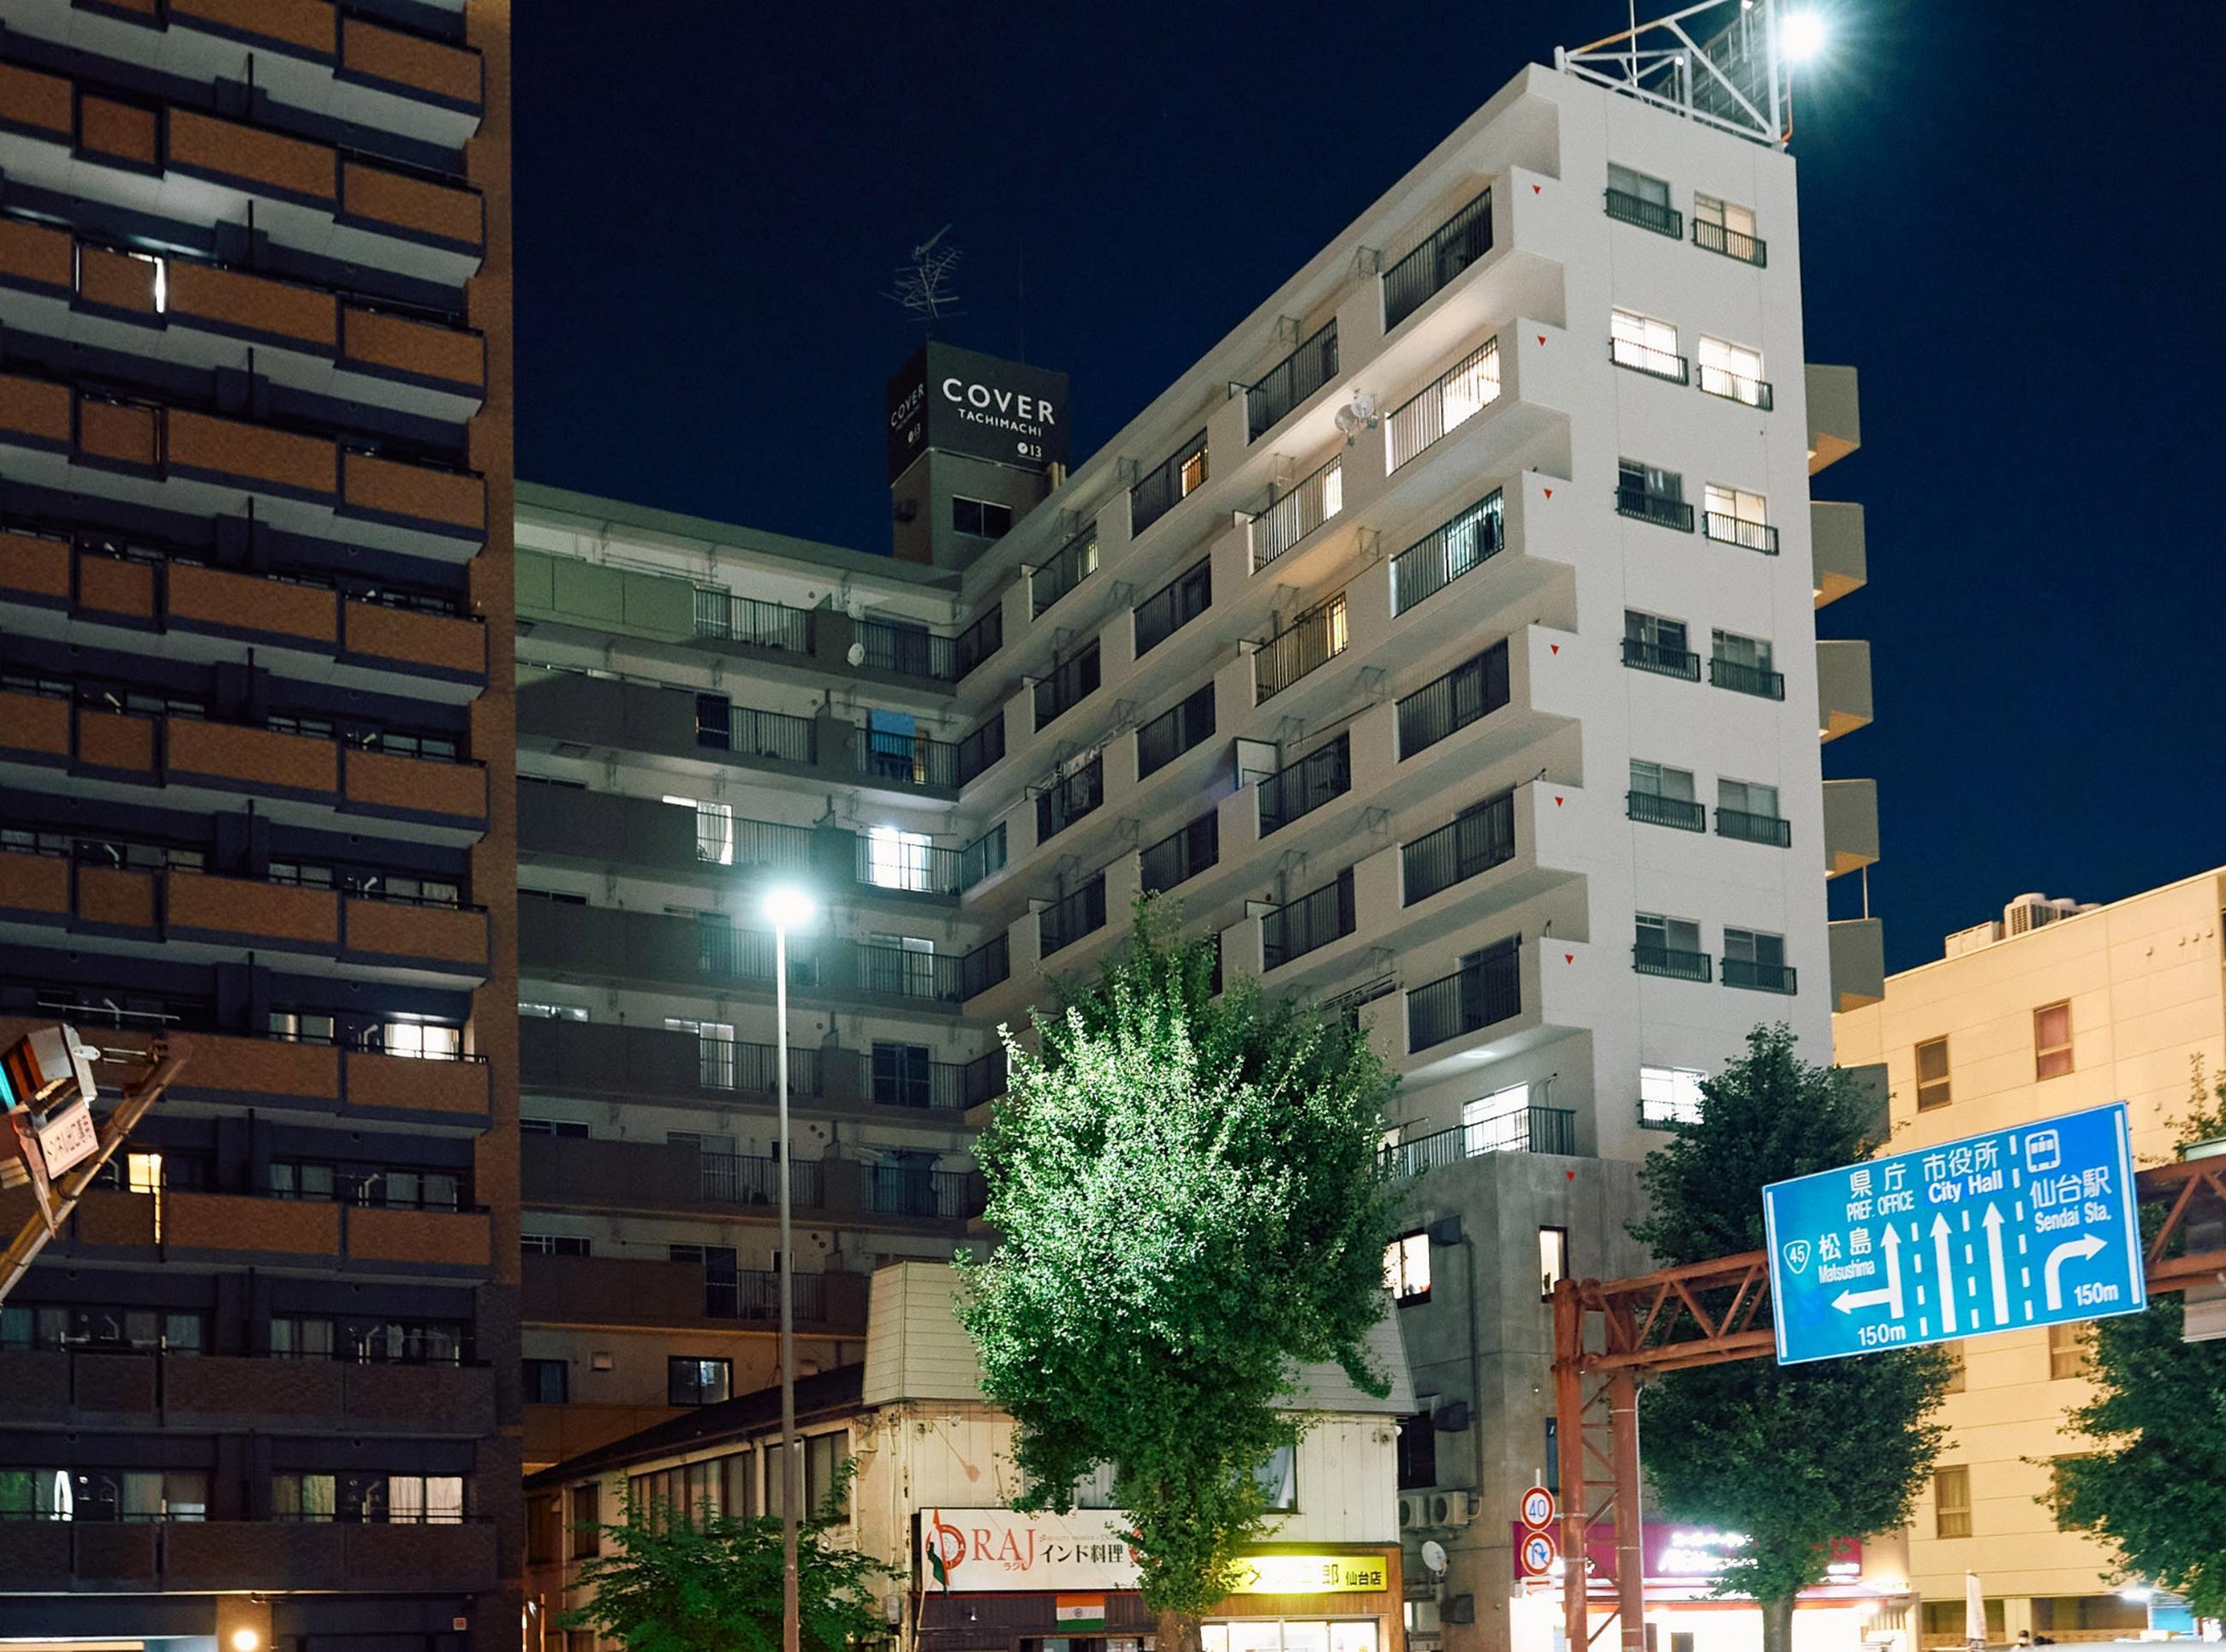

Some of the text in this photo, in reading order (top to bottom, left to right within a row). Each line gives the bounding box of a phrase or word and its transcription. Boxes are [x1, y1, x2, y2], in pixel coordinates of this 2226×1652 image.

[891, 383, 925, 426] COVER
[943, 377, 1055, 425] COVER
[958, 408, 1041, 437] TACHIMACHI
[1922, 1139, 1999, 1182] 市役所
[1849, 1162, 1907, 1199] 県庁
[1928, 1169, 2003, 1204] City Hall
[2030, 1166, 2112, 1209] 仙台駅
[1846, 1190, 1914, 1222] PREF. OFFICE
[2034, 1201, 2111, 1233] Sendai Sta.
[1789, 1245, 1806, 1263] 45
[1818, 1227, 1872, 1263] 松島
[1818, 1259, 1876, 1284] Matsushima
[2074, 1282, 2120, 1307] 150m
[1857, 1323, 1908, 1346] 150m
[1528, 1499, 1546, 1518] 40
[971, 1527, 1037, 1572] RAJ
[1040, 1544, 1124, 1564] インド料理
[1345, 1571, 1382, 1585] 仙台店
